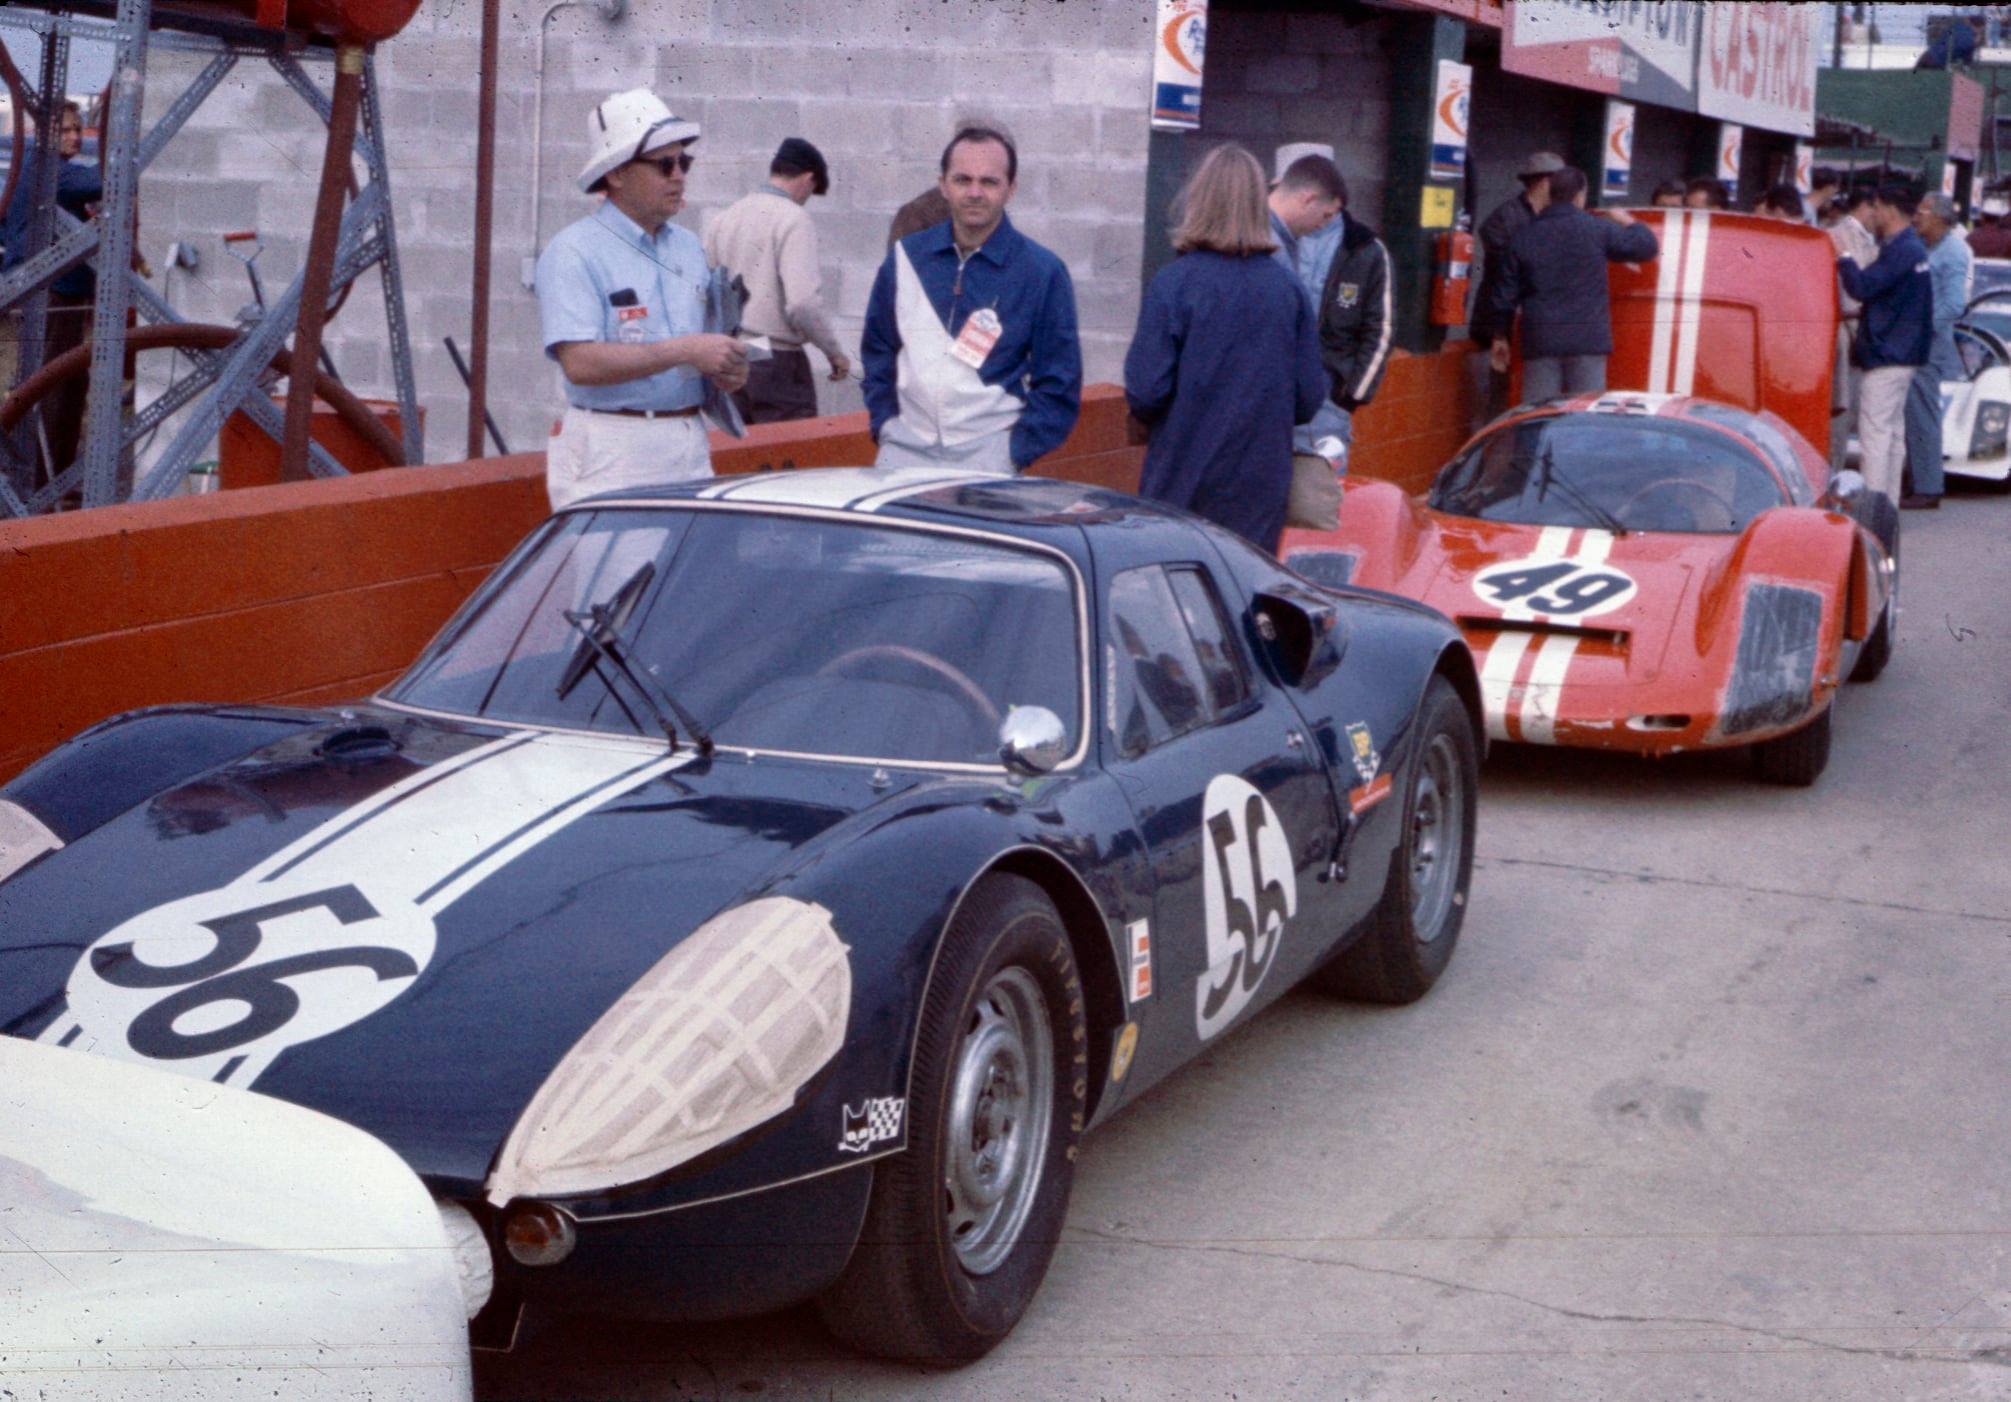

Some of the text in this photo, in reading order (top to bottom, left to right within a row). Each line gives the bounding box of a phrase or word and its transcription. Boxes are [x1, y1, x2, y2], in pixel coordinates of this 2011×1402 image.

[1710, 2, 1810, 112] CASTROL
[1481, 561, 1633, 615] 49
[90, 883, 419, 1060] 56
[1203, 794, 1289, 1020] 56
